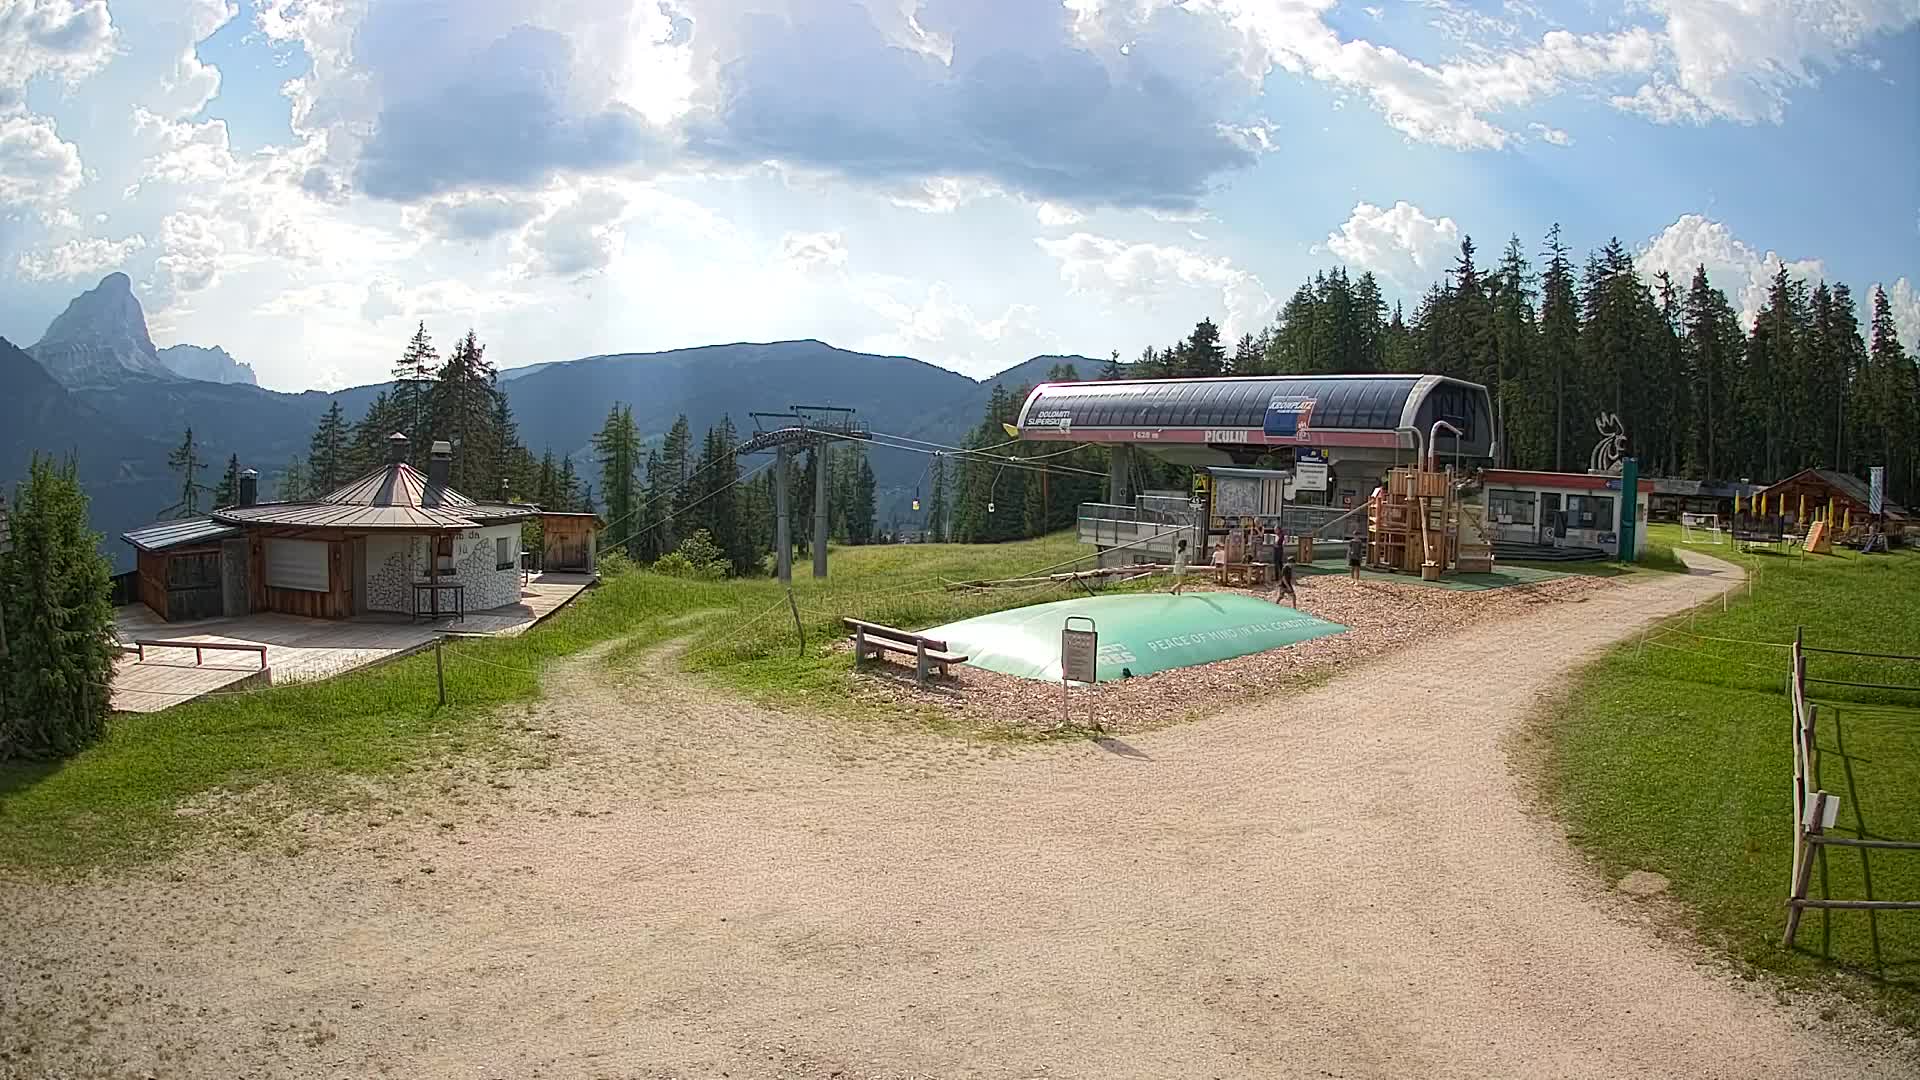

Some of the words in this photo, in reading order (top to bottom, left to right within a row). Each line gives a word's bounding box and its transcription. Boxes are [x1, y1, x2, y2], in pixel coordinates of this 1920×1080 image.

[1038, 410, 1070, 418] DOLOMITI
[1028, 418, 1060, 426] SUPERSKI
[1204, 430, 1248, 443] PICULIN
[1148, 637, 1191, 652] PEACE
[1190, 632, 1208, 645] OF
[1207, 628, 1239, 641] MIND
